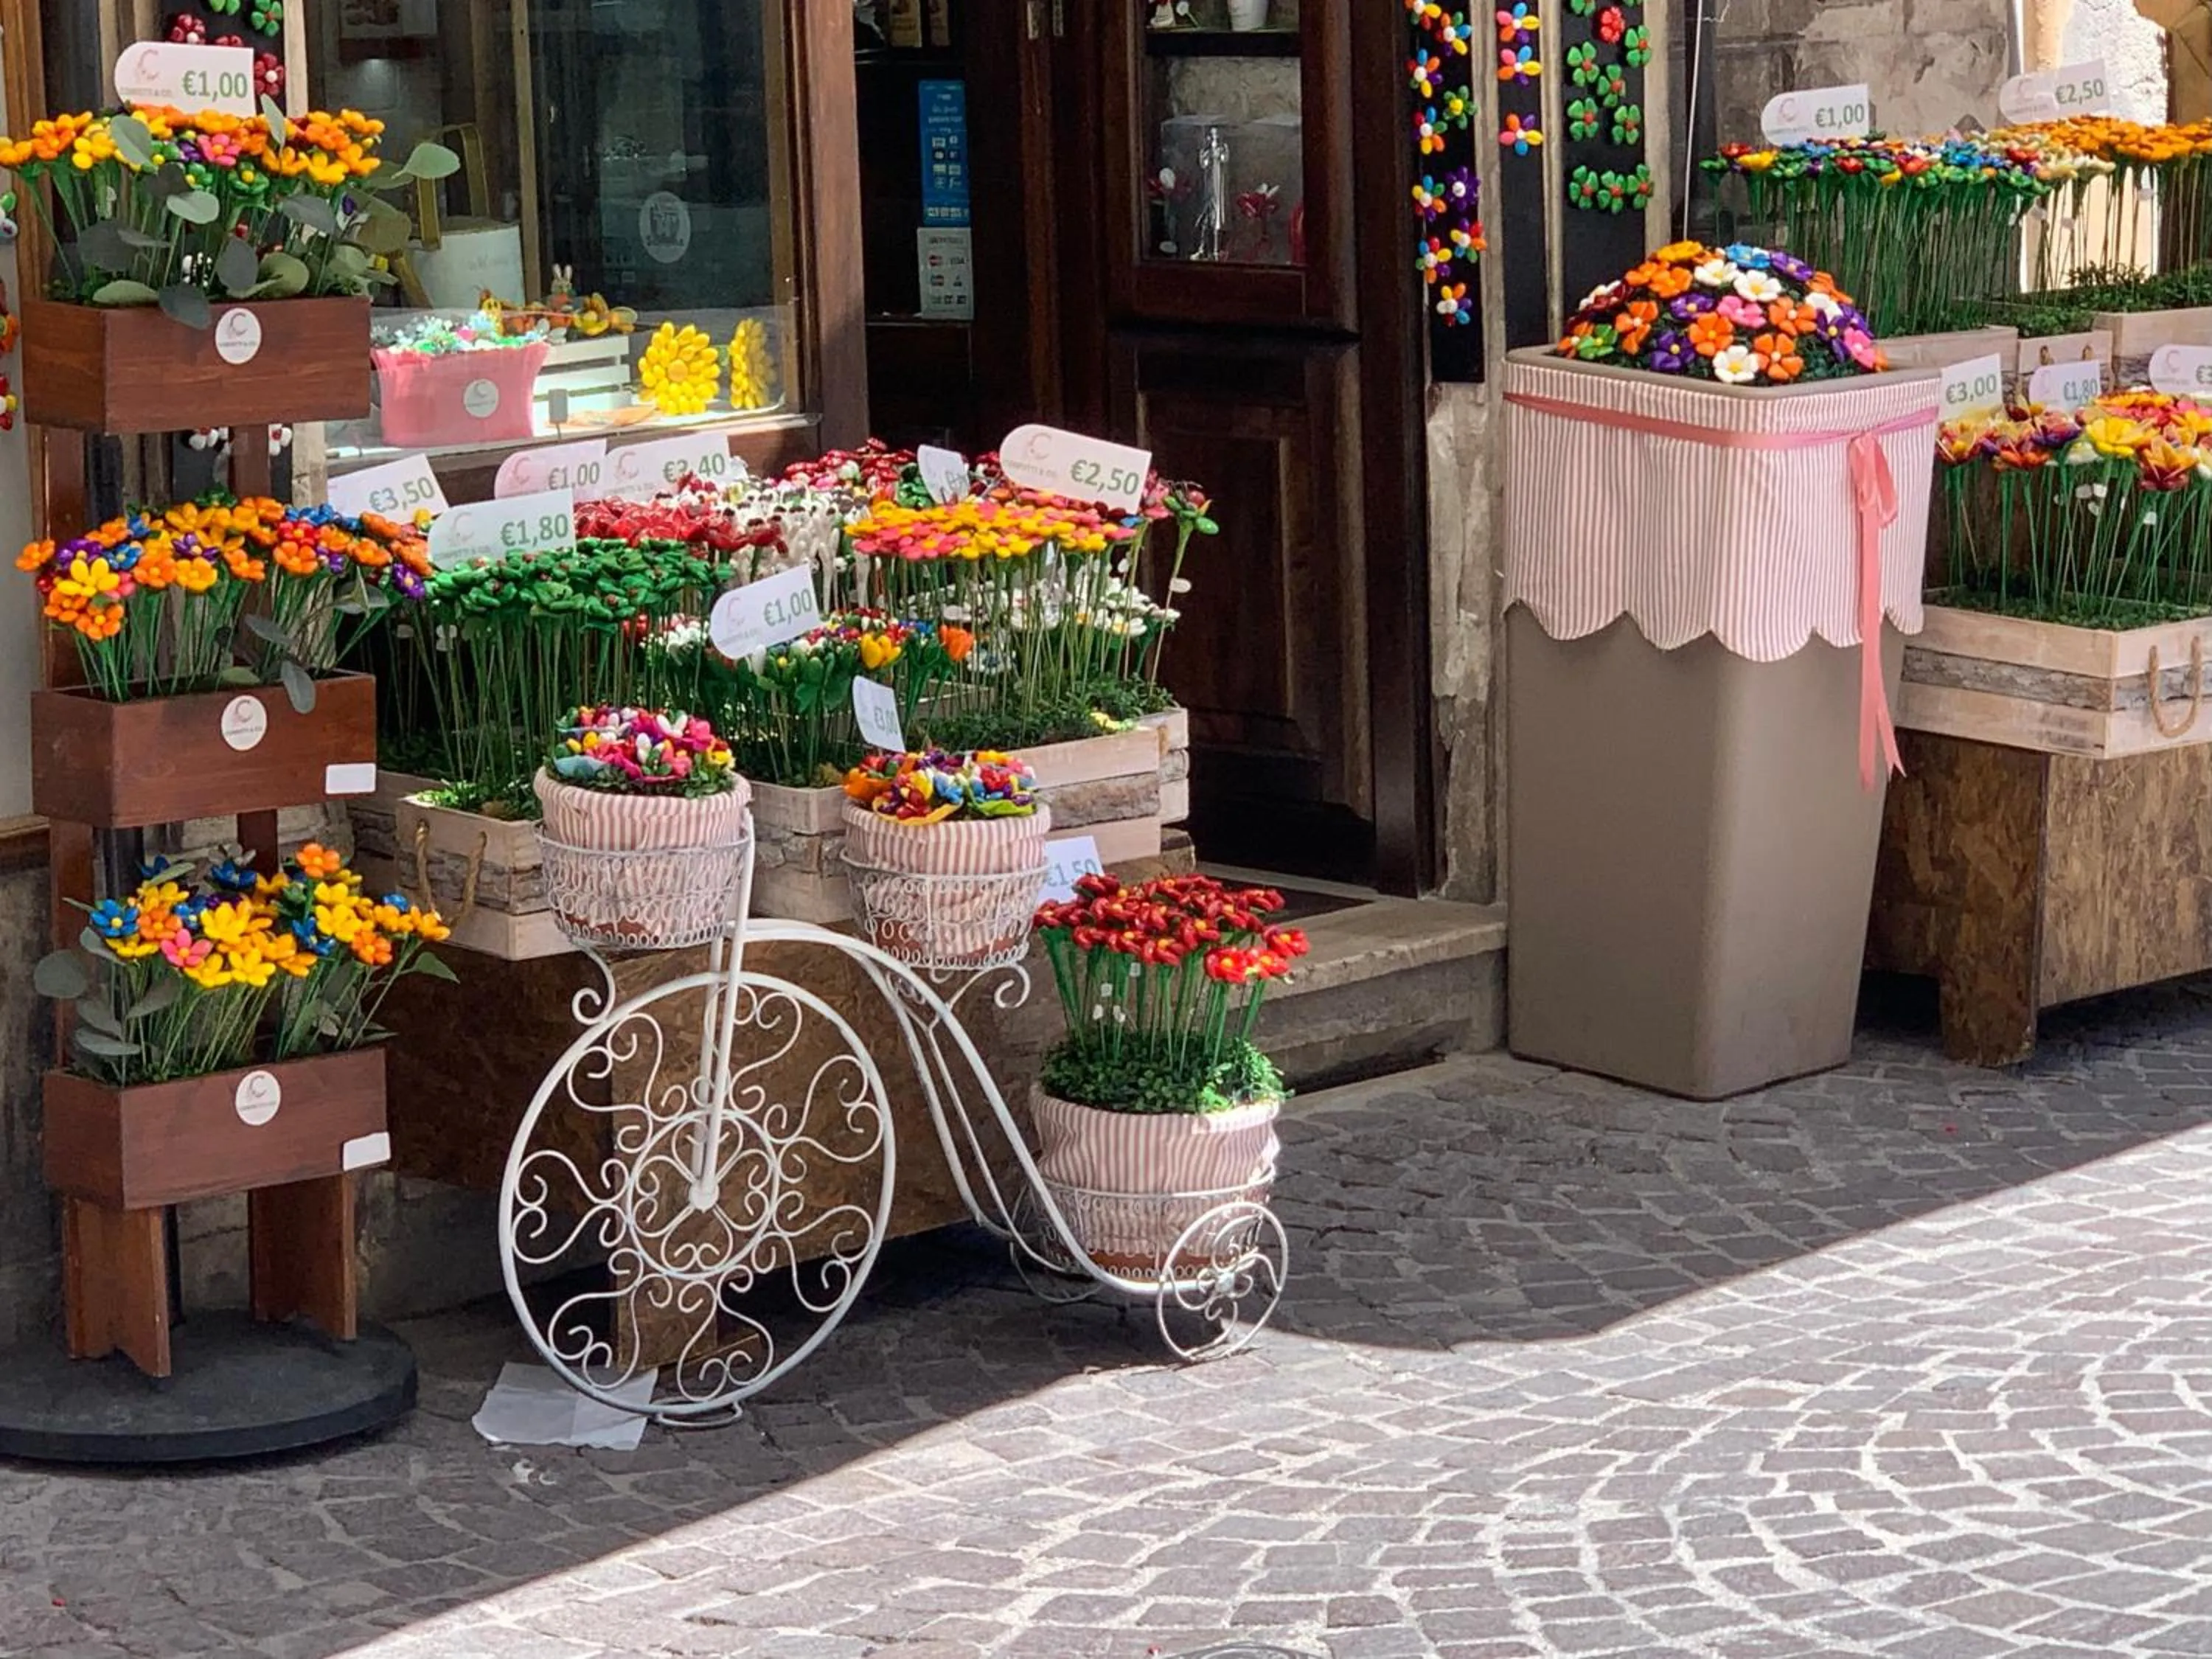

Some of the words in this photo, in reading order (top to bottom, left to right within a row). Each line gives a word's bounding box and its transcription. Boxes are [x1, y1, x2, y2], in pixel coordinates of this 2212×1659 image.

[182, 71, 248, 102] €1,00
[2056, 78, 2104, 105] €2,50
[1815, 104, 1865, 130] €1,00
[1946, 374, 1997, 404] €3,00
[2064, 378, 2098, 404] €1,80
[549, 462, 600, 491] €1,00
[663, 453, 726, 484] €340
[1071, 459, 1139, 496] €2,50
[369, 477, 435, 512] €3,50
[501, 514, 568, 546] €1,80
[763, 588, 812, 627] €1,00
